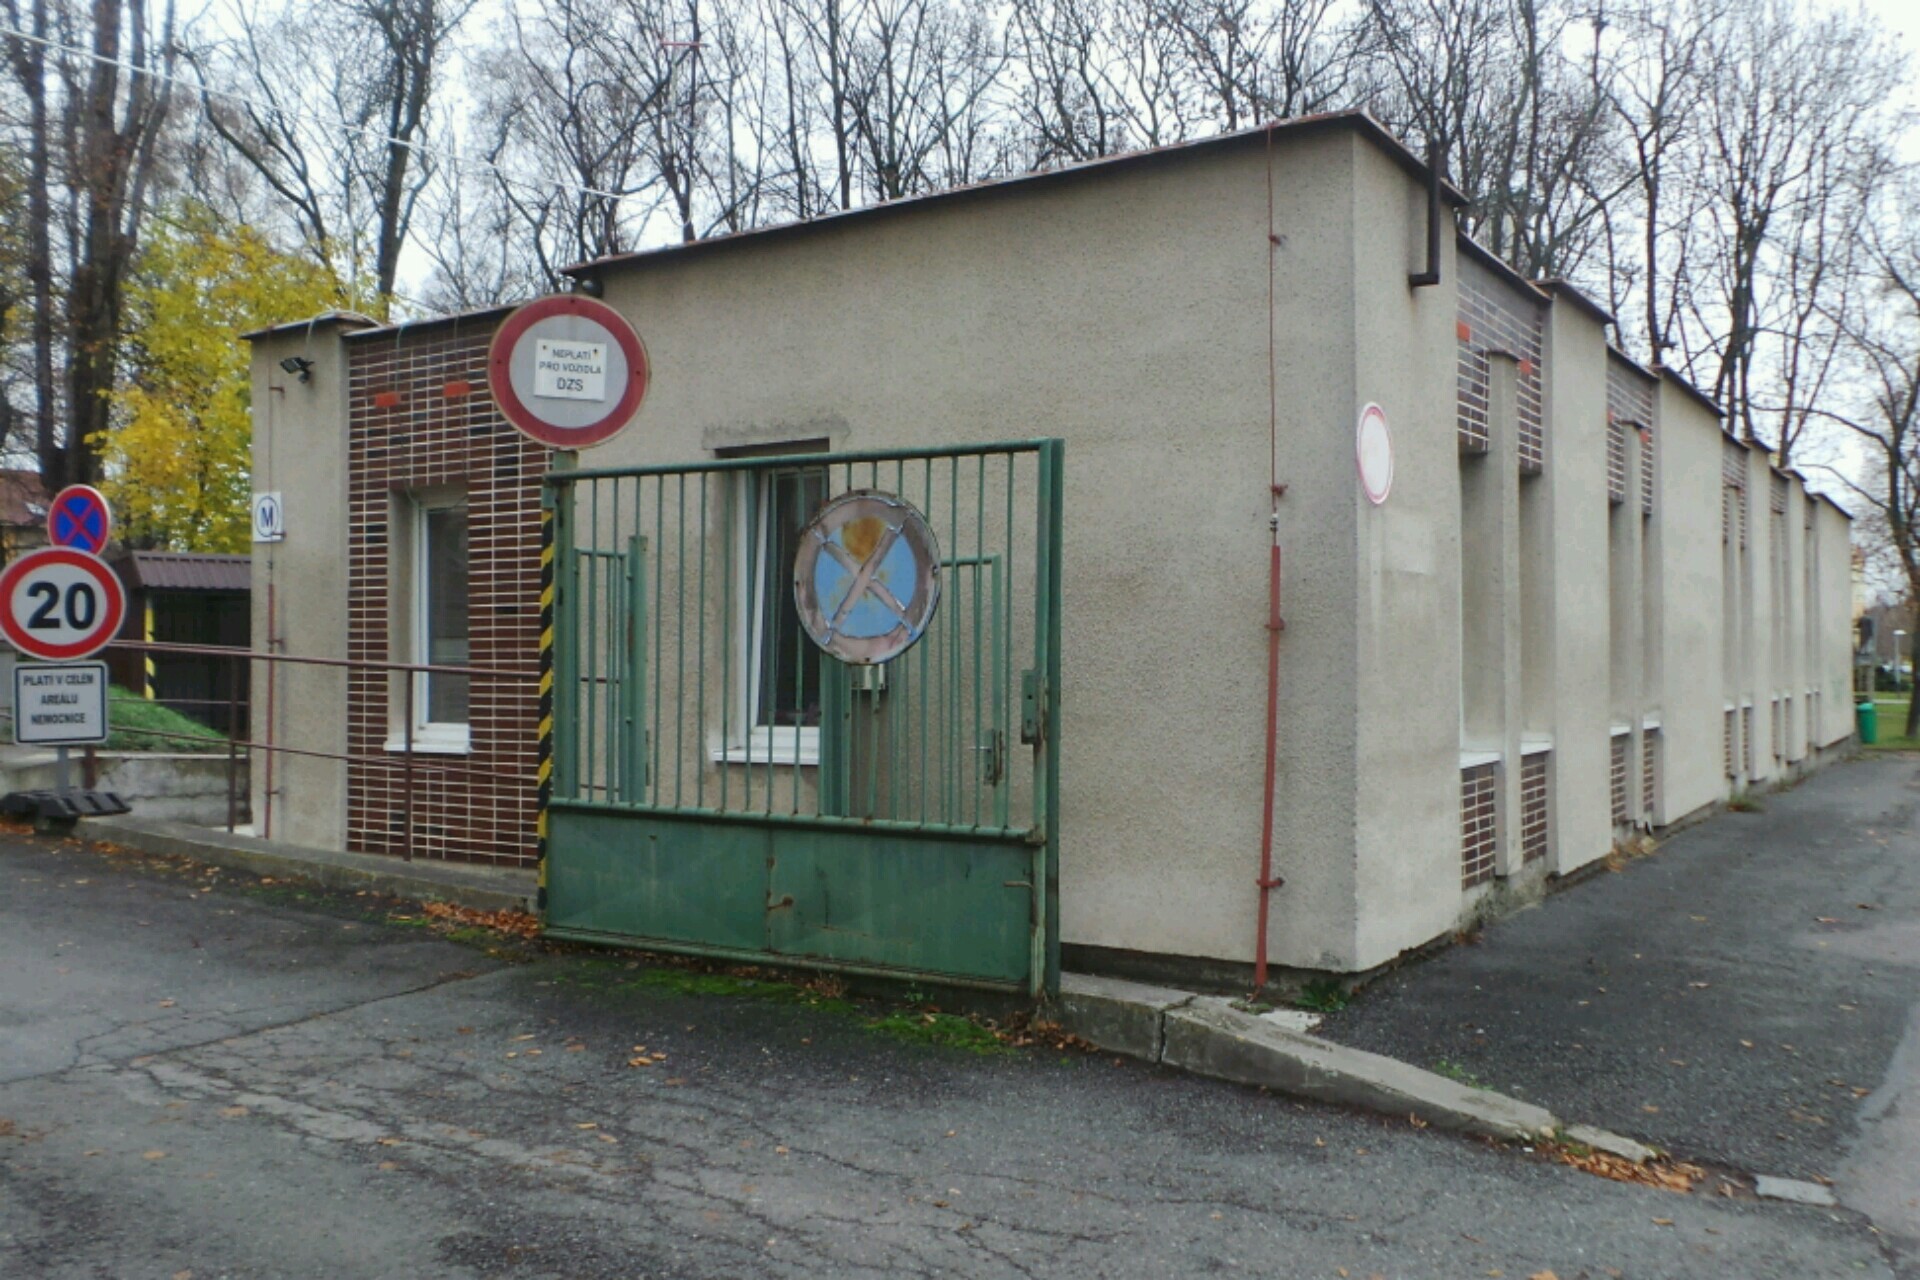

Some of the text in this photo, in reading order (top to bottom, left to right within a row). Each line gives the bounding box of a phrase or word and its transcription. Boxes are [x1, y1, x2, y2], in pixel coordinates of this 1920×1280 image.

[539, 361, 602, 374] PRO VOZIDLA
[556, 377, 584, 392] DZS
[261, 505, 273, 528] M
[27, 581, 96, 630] 20
[55, 675, 63, 684] V
